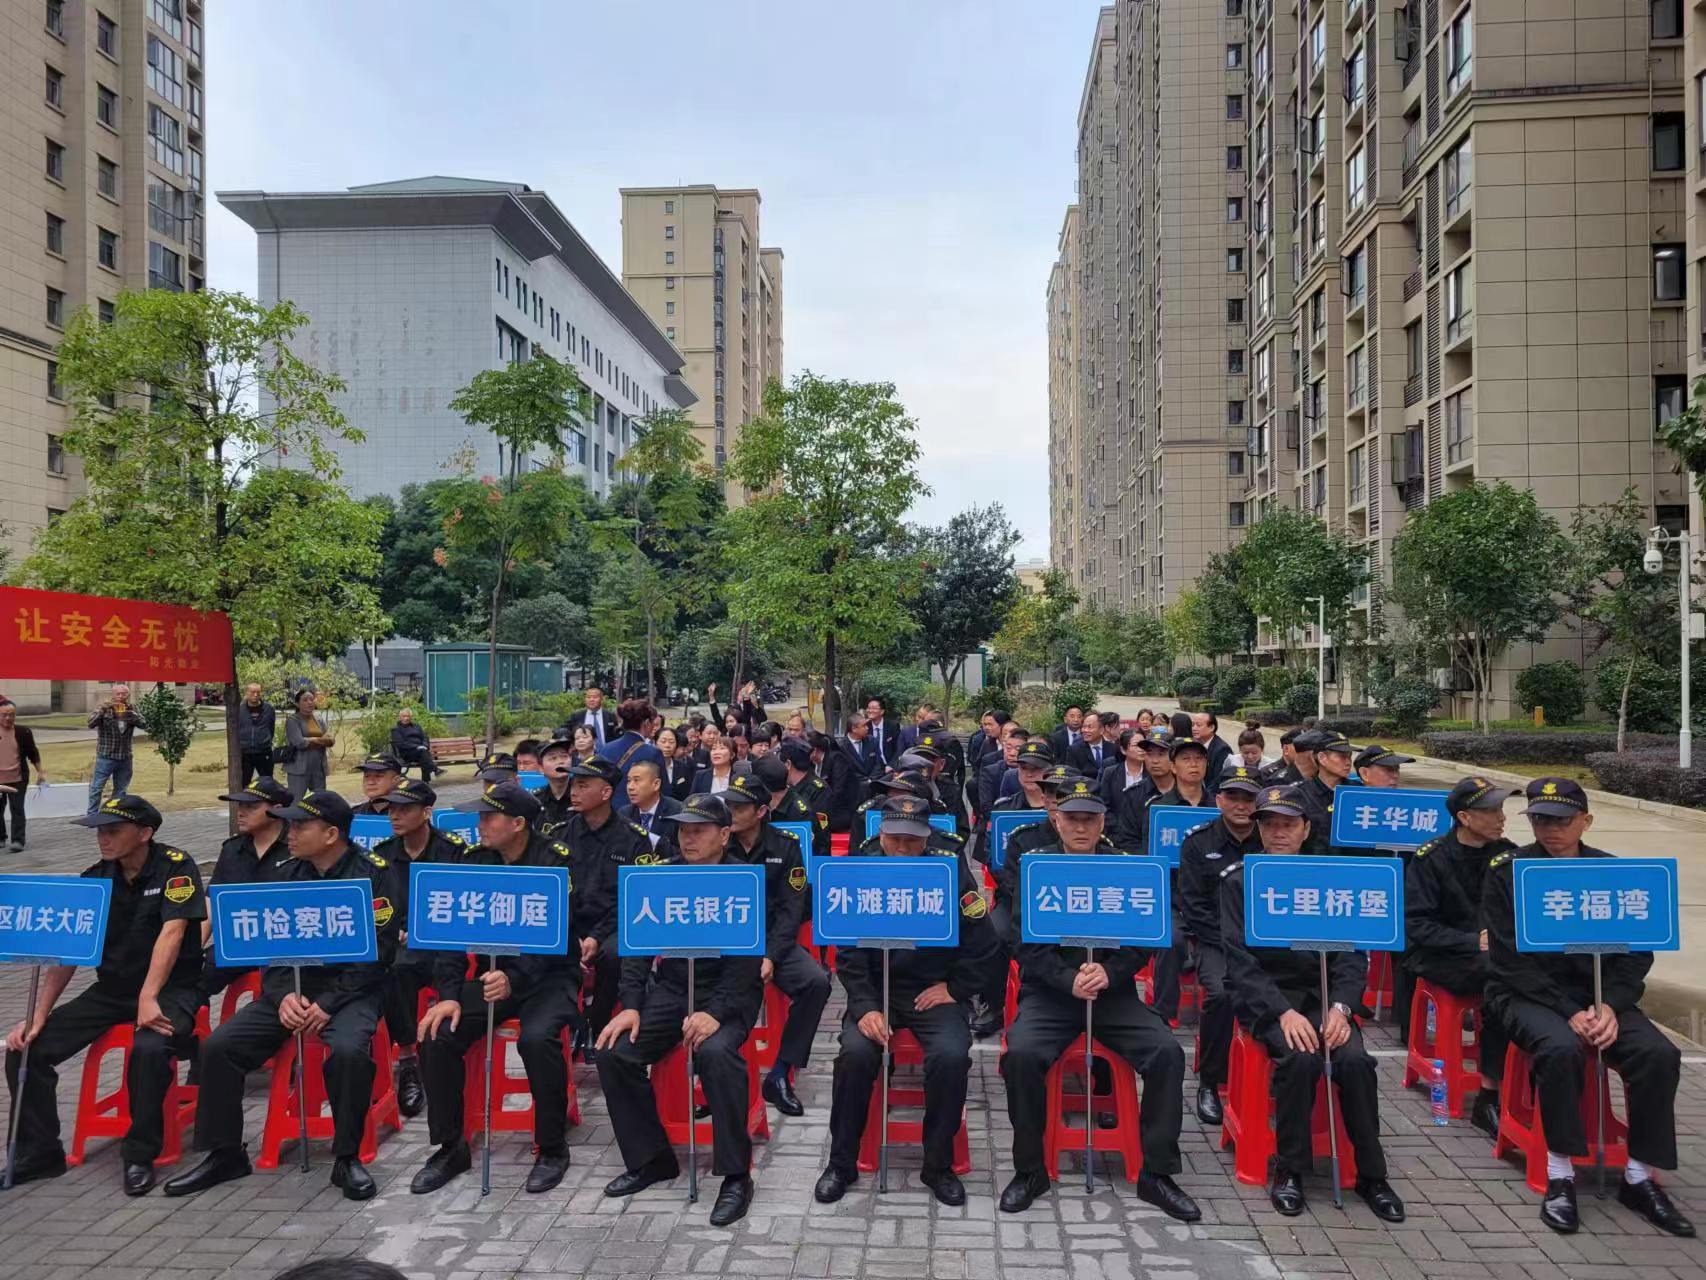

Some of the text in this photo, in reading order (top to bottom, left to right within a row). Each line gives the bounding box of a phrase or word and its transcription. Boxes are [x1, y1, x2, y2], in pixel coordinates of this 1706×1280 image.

[14, 607, 200, 654] 让安全无忧
[1352, 805, 1439, 833] 丰华城
[427, 890, 549, 928] 君华御庭
[632, 896, 752, 925] 人民银行
[826, 886, 945, 916] 外滩新城
[1036, 885, 1156, 915] 公园壹号
[1260, 886, 1389, 919] 七里桥堡
[1543, 888, 1650, 922] 幸福湾
[232, 904, 356, 942] 市检察院
